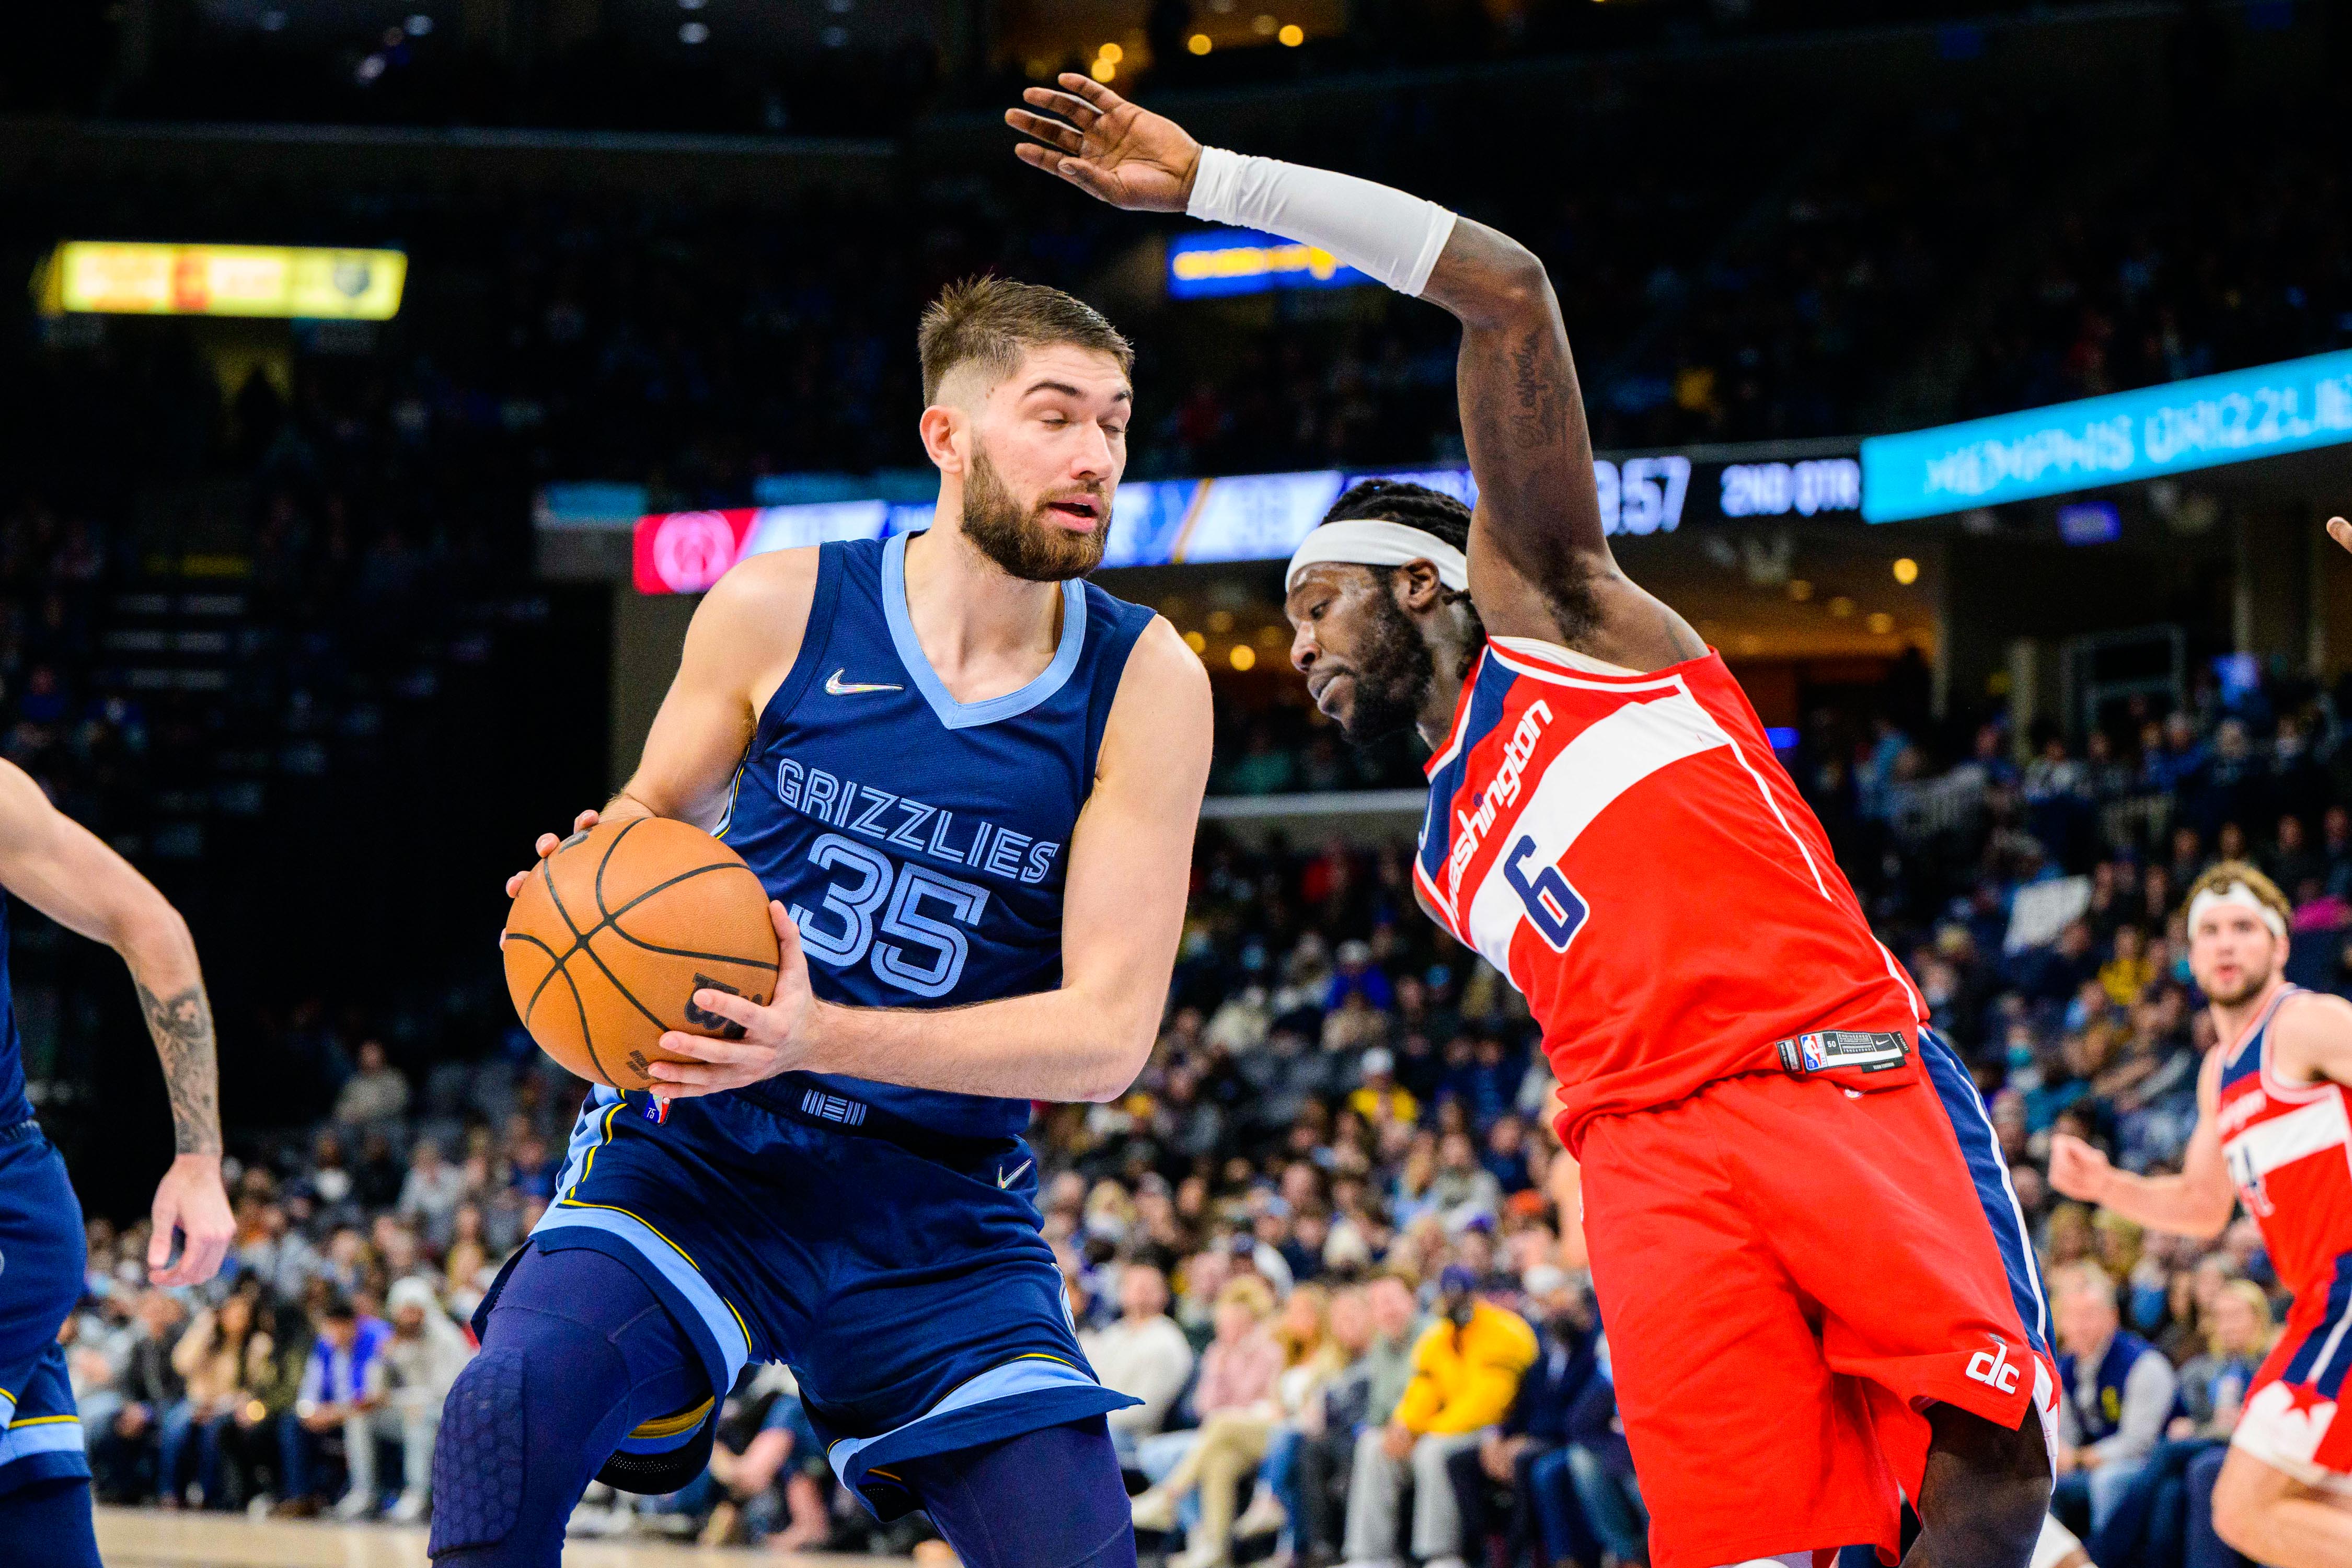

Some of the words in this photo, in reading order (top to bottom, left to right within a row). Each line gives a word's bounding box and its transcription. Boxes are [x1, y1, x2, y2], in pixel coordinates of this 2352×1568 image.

[777, 758, 1060, 883] GRIZZLIES
[788, 833, 991, 997] 35
[1504, 835, 1588, 952] 6
[1808, 1059, 1815, 1068] 75
[646, 1107, 656, 1119] 75
[1965, 1341, 2020, 1394] dc
